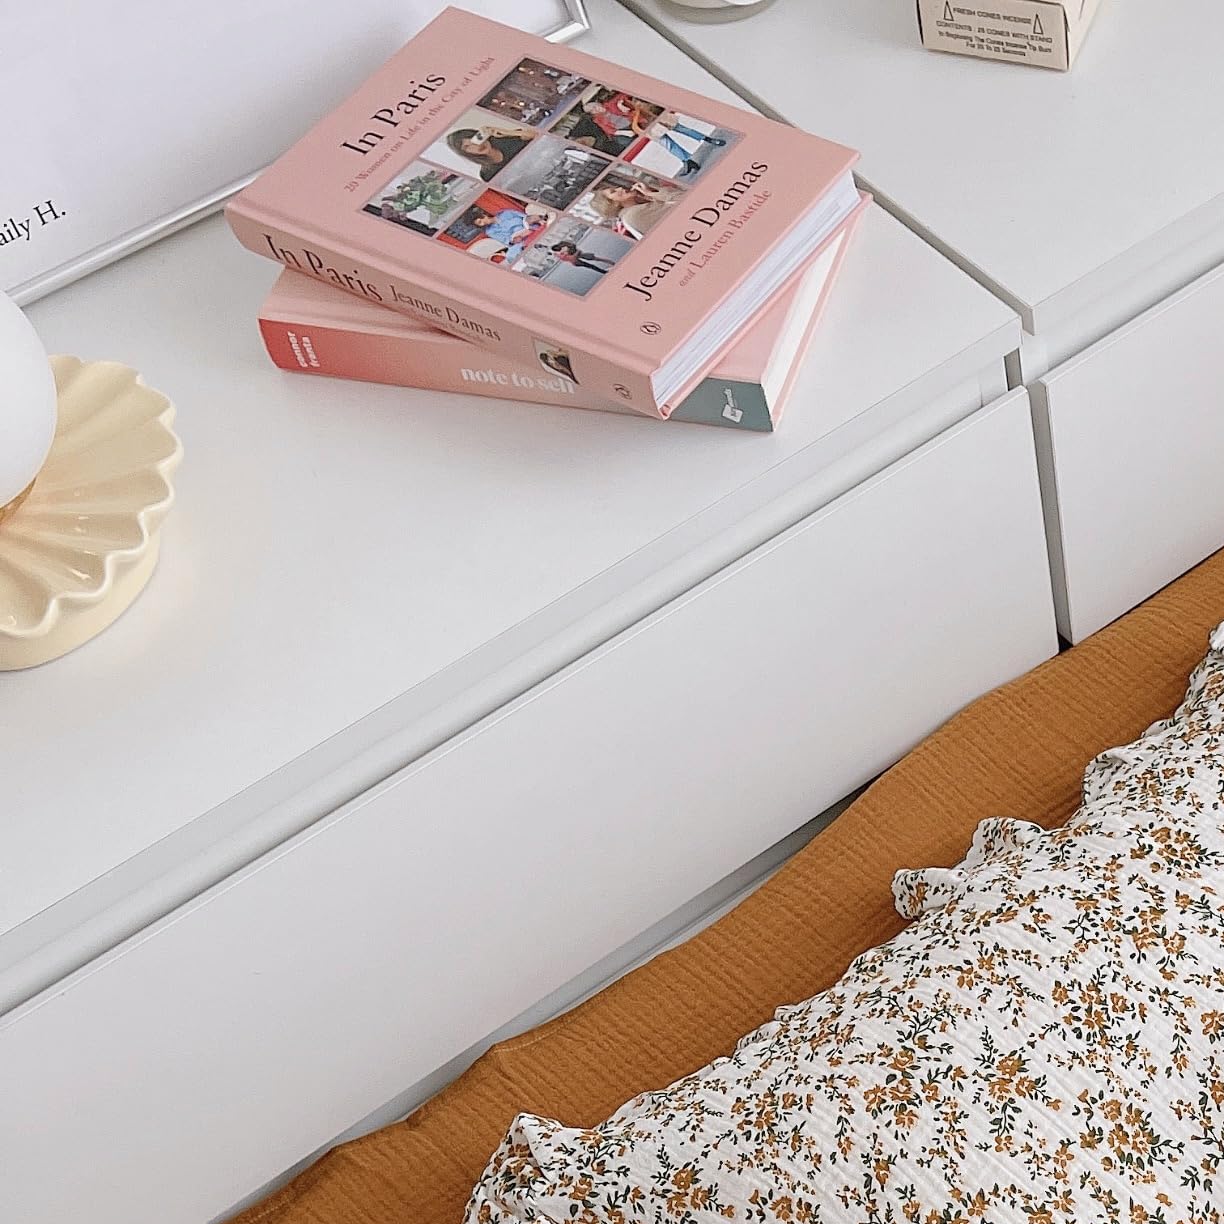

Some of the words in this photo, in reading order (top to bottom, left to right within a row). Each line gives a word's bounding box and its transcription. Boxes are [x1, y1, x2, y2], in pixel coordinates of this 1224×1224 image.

[340, 131, 385, 156] In
[370, 73, 446, 128] Paris
[357, 151, 392, 181] Women
[429, 103, 446, 118] the
[33, 200, 66, 226] H.
[623, 230, 702, 302] Jeanne
[689, 161, 768, 228] Damas
[679, 268, 696, 287] and
[690, 230, 737, 270] Lauren
[729, 189, 773, 230] Bastide
[263, 233, 302, 268] In
[302, 248, 383, 301] Paris
[389, 284, 443, 317] Jeanne
[446, 307, 501, 342] Damas
[460, 366, 509, 384] note
[511, 369, 535, 390] to
